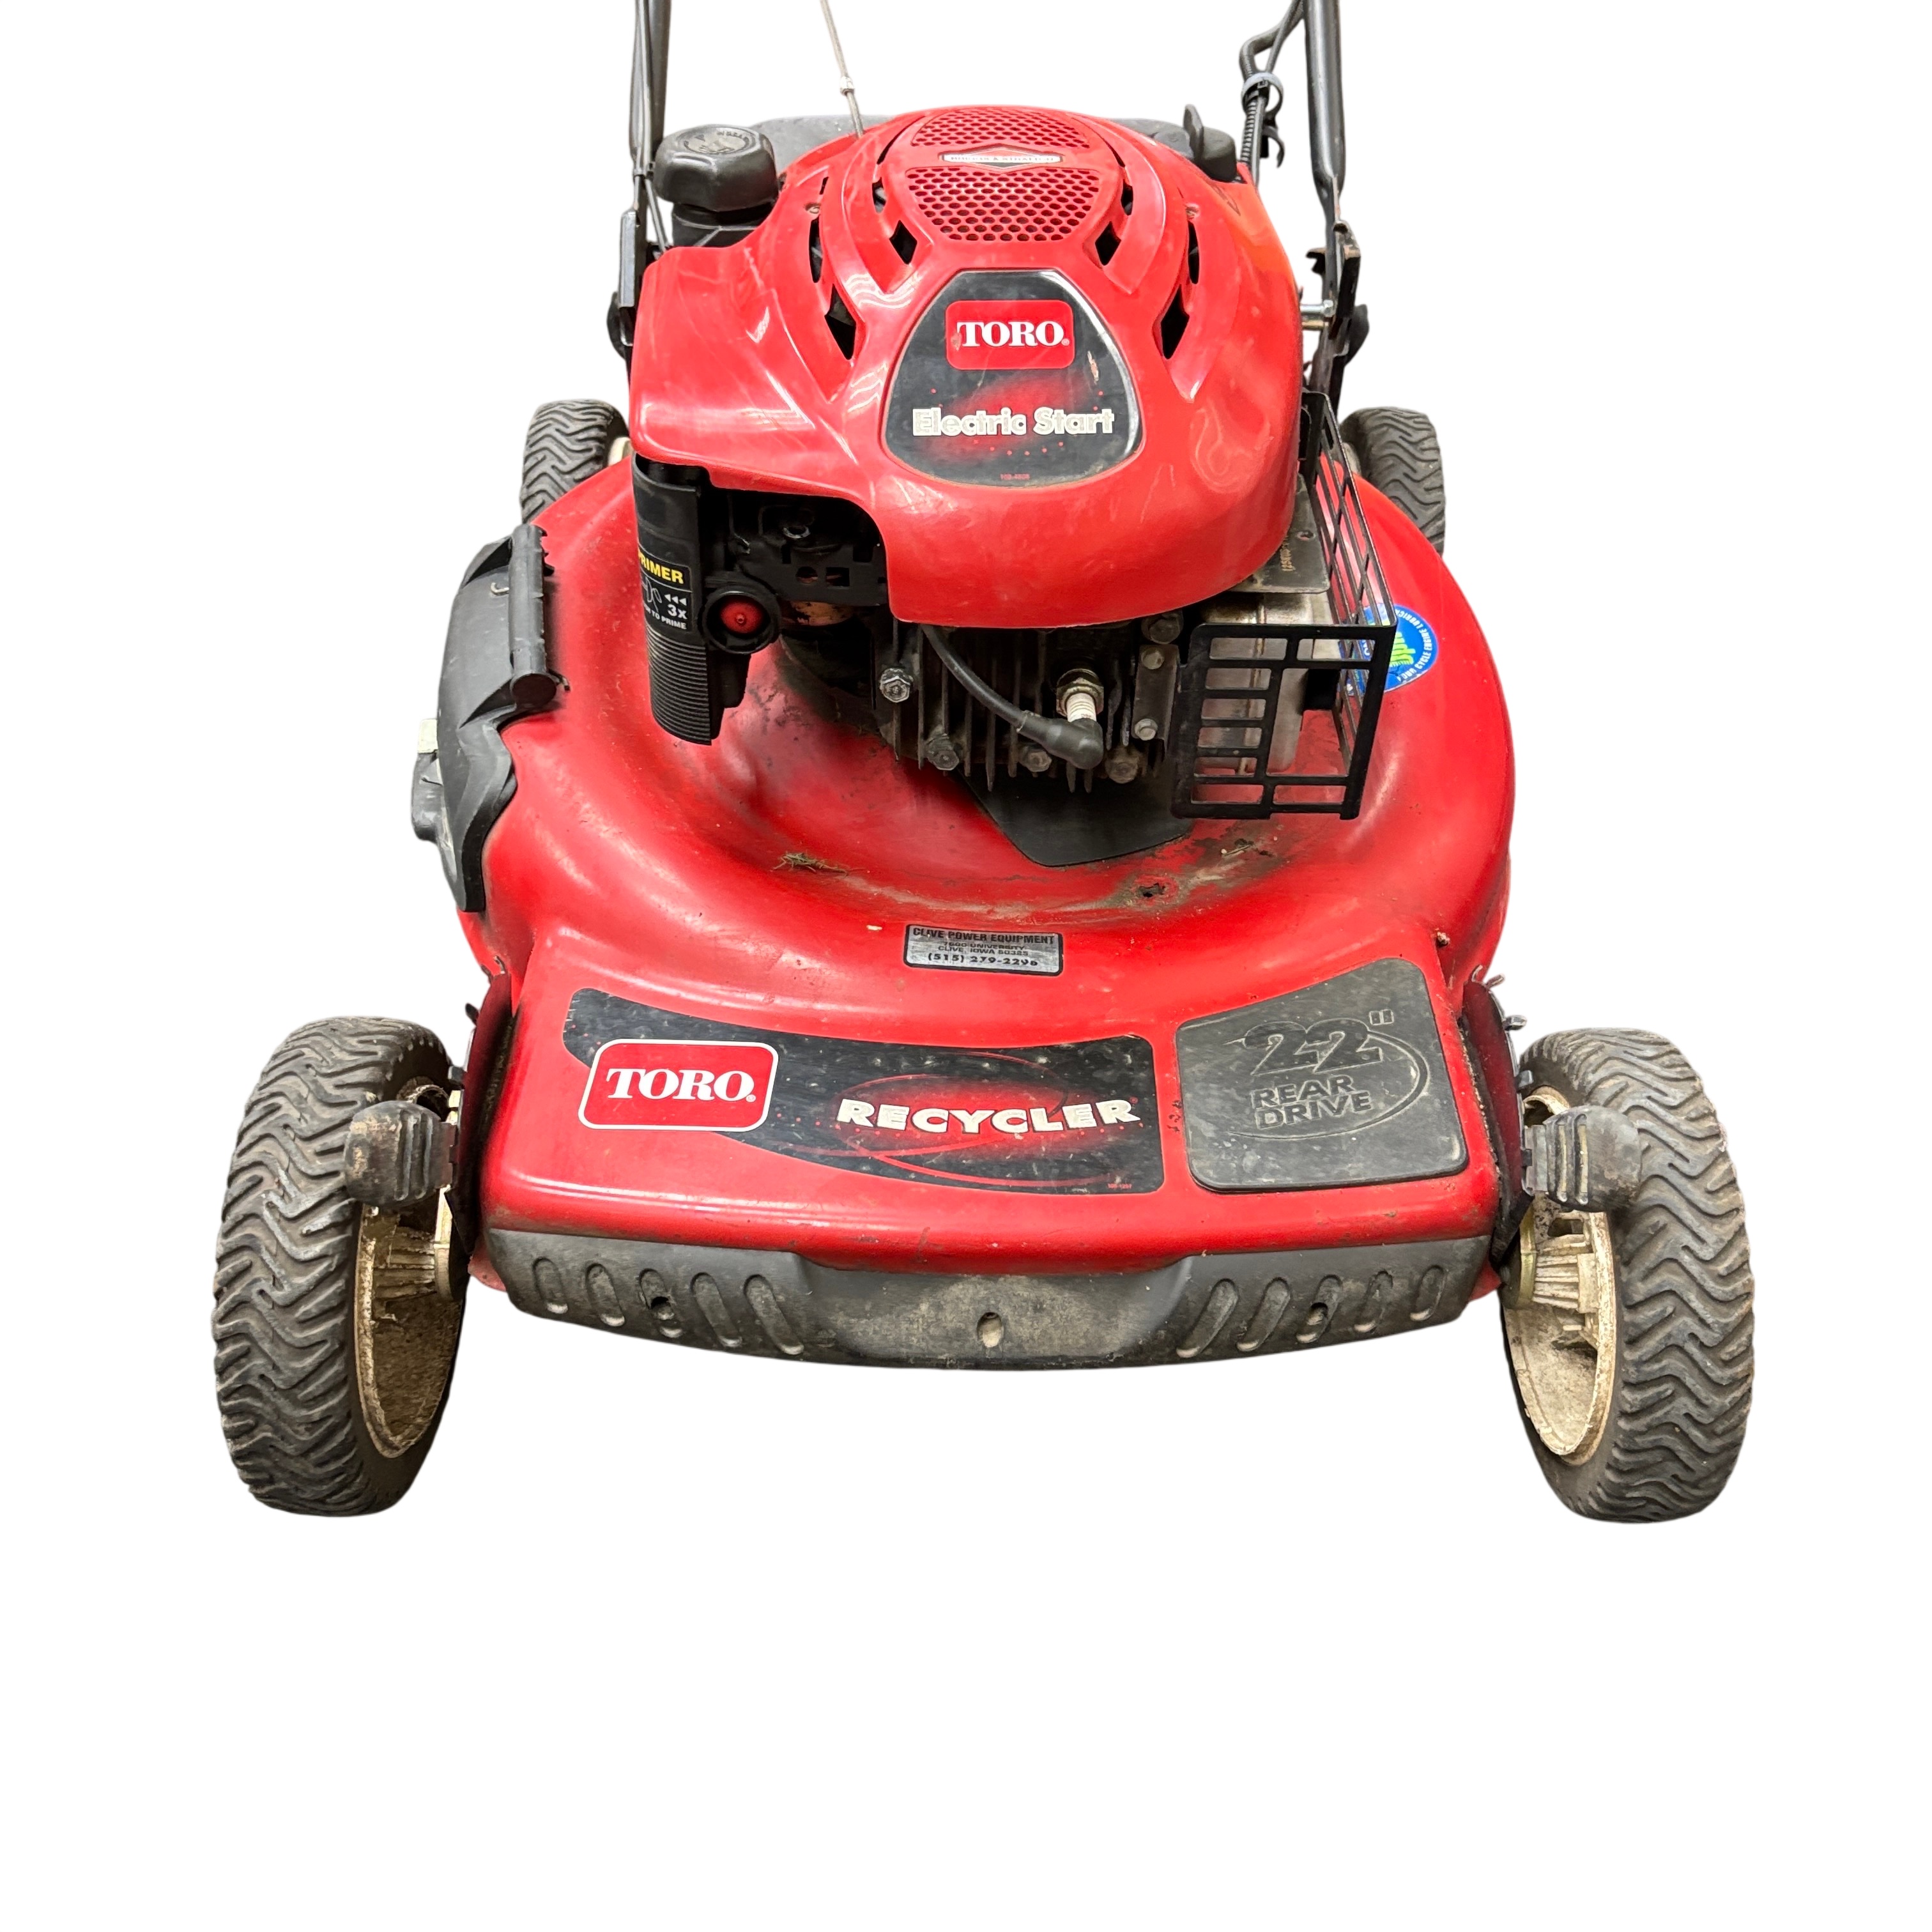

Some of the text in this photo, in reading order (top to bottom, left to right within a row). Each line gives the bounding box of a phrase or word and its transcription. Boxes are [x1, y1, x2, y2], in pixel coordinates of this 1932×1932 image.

[957, 321, 1064, 347] TORO
[912, 407, 1115, 436] Electric Start
[652, 610, 687, 629] TO PRIME
[1395, 609, 1423, 629] LUBRICA
[1419, 628, 1432, 650] ENGINE
[1414, 651, 1431, 669] CYCLE
[913, 928, 1054, 944] CLIVE POWER EQUIPMENT
[928, 953, 964, 963] (515)
[606, 1068, 755, 1102] TORO
[1250, 1075, 1356, 1110] REAR
[836, 1099, 1142, 1135] RECYCLER
[1254, 1091, 1372, 1130] DRIVE
